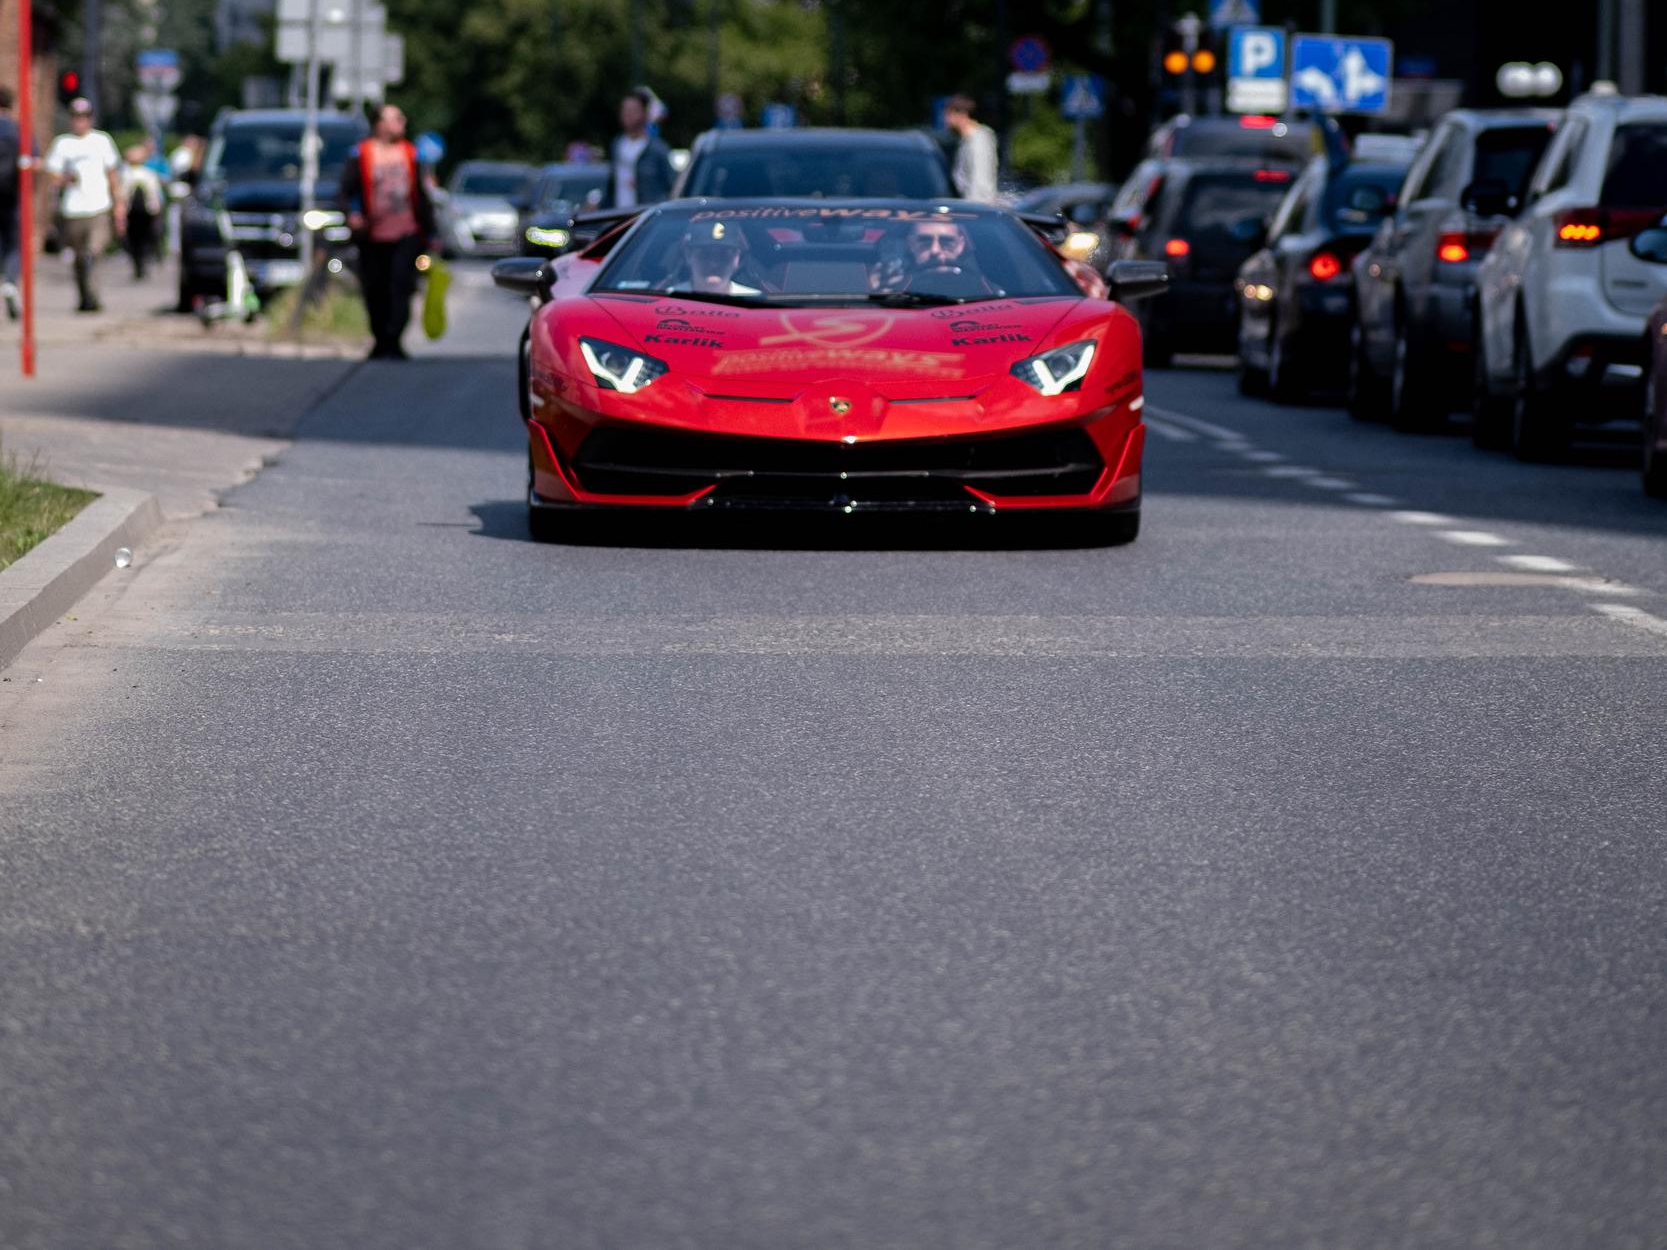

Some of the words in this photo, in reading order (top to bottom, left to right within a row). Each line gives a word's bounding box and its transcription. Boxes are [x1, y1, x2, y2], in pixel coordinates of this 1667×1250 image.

[1240, 31, 1277, 76] P
[643, 334, 724, 348] Karlik
[952, 334, 1032, 347] Karlik
